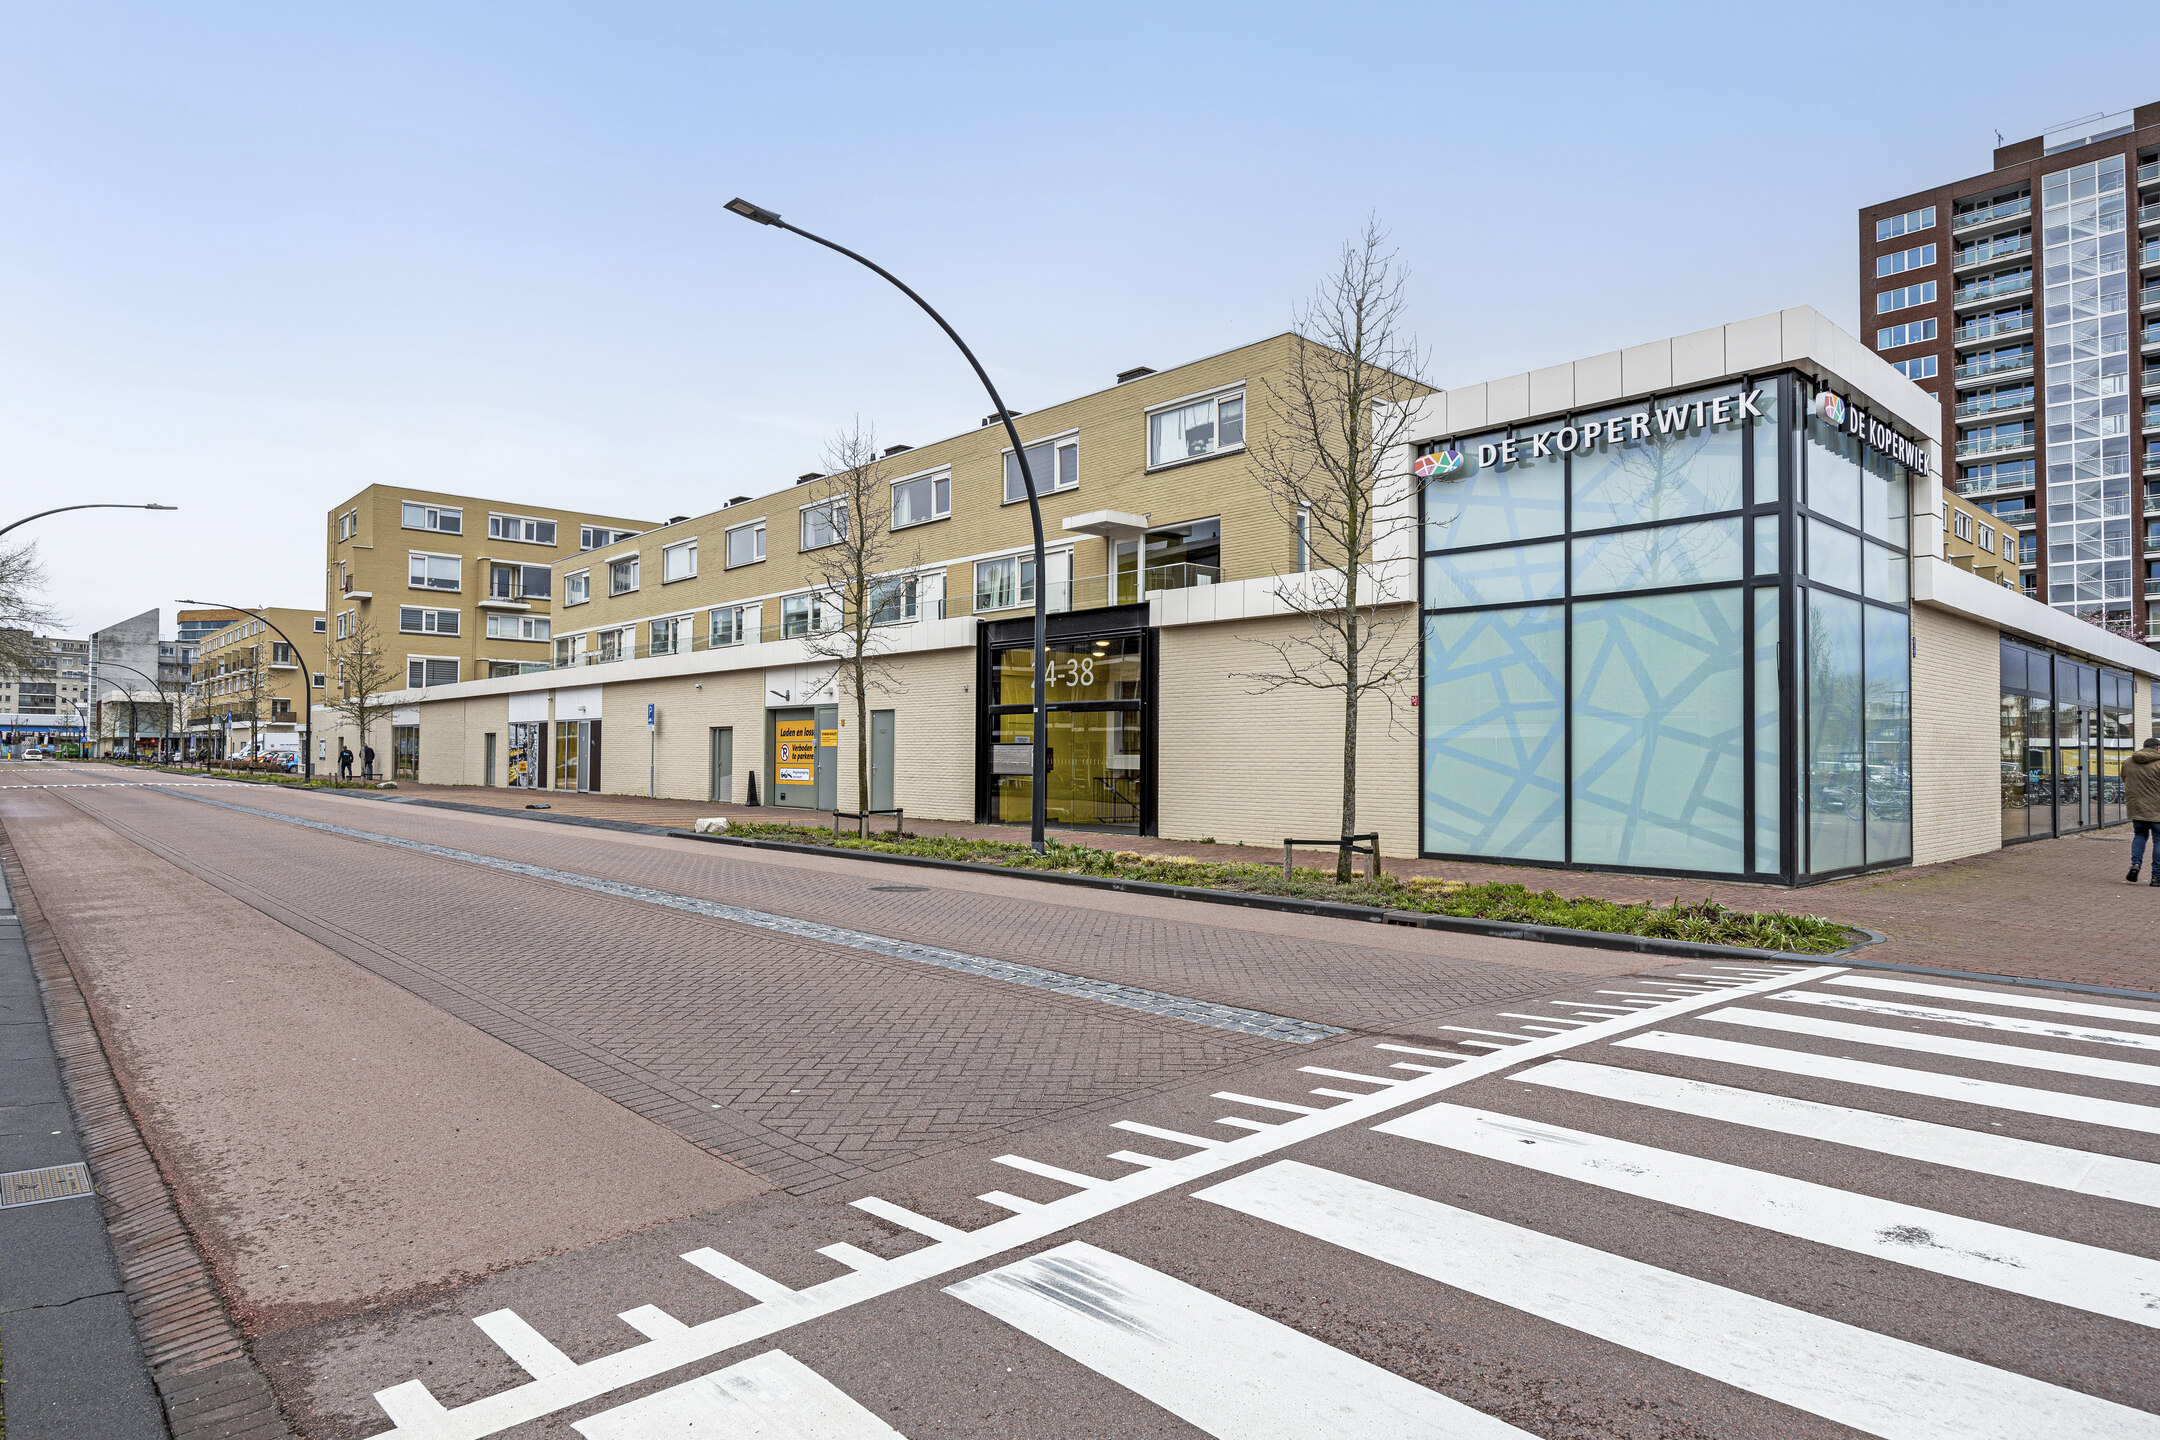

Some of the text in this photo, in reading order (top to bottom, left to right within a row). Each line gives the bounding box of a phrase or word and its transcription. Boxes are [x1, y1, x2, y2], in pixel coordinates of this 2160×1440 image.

[1478, 389, 1765, 469] DE KOPERWIEK
[1849, 404, 1930, 477] DE KOPERWIEK
[1031, 657, 1094, 689] 4-38
[804, 727, 814, 736] loss
[797, 752, 814, 761] parkere
